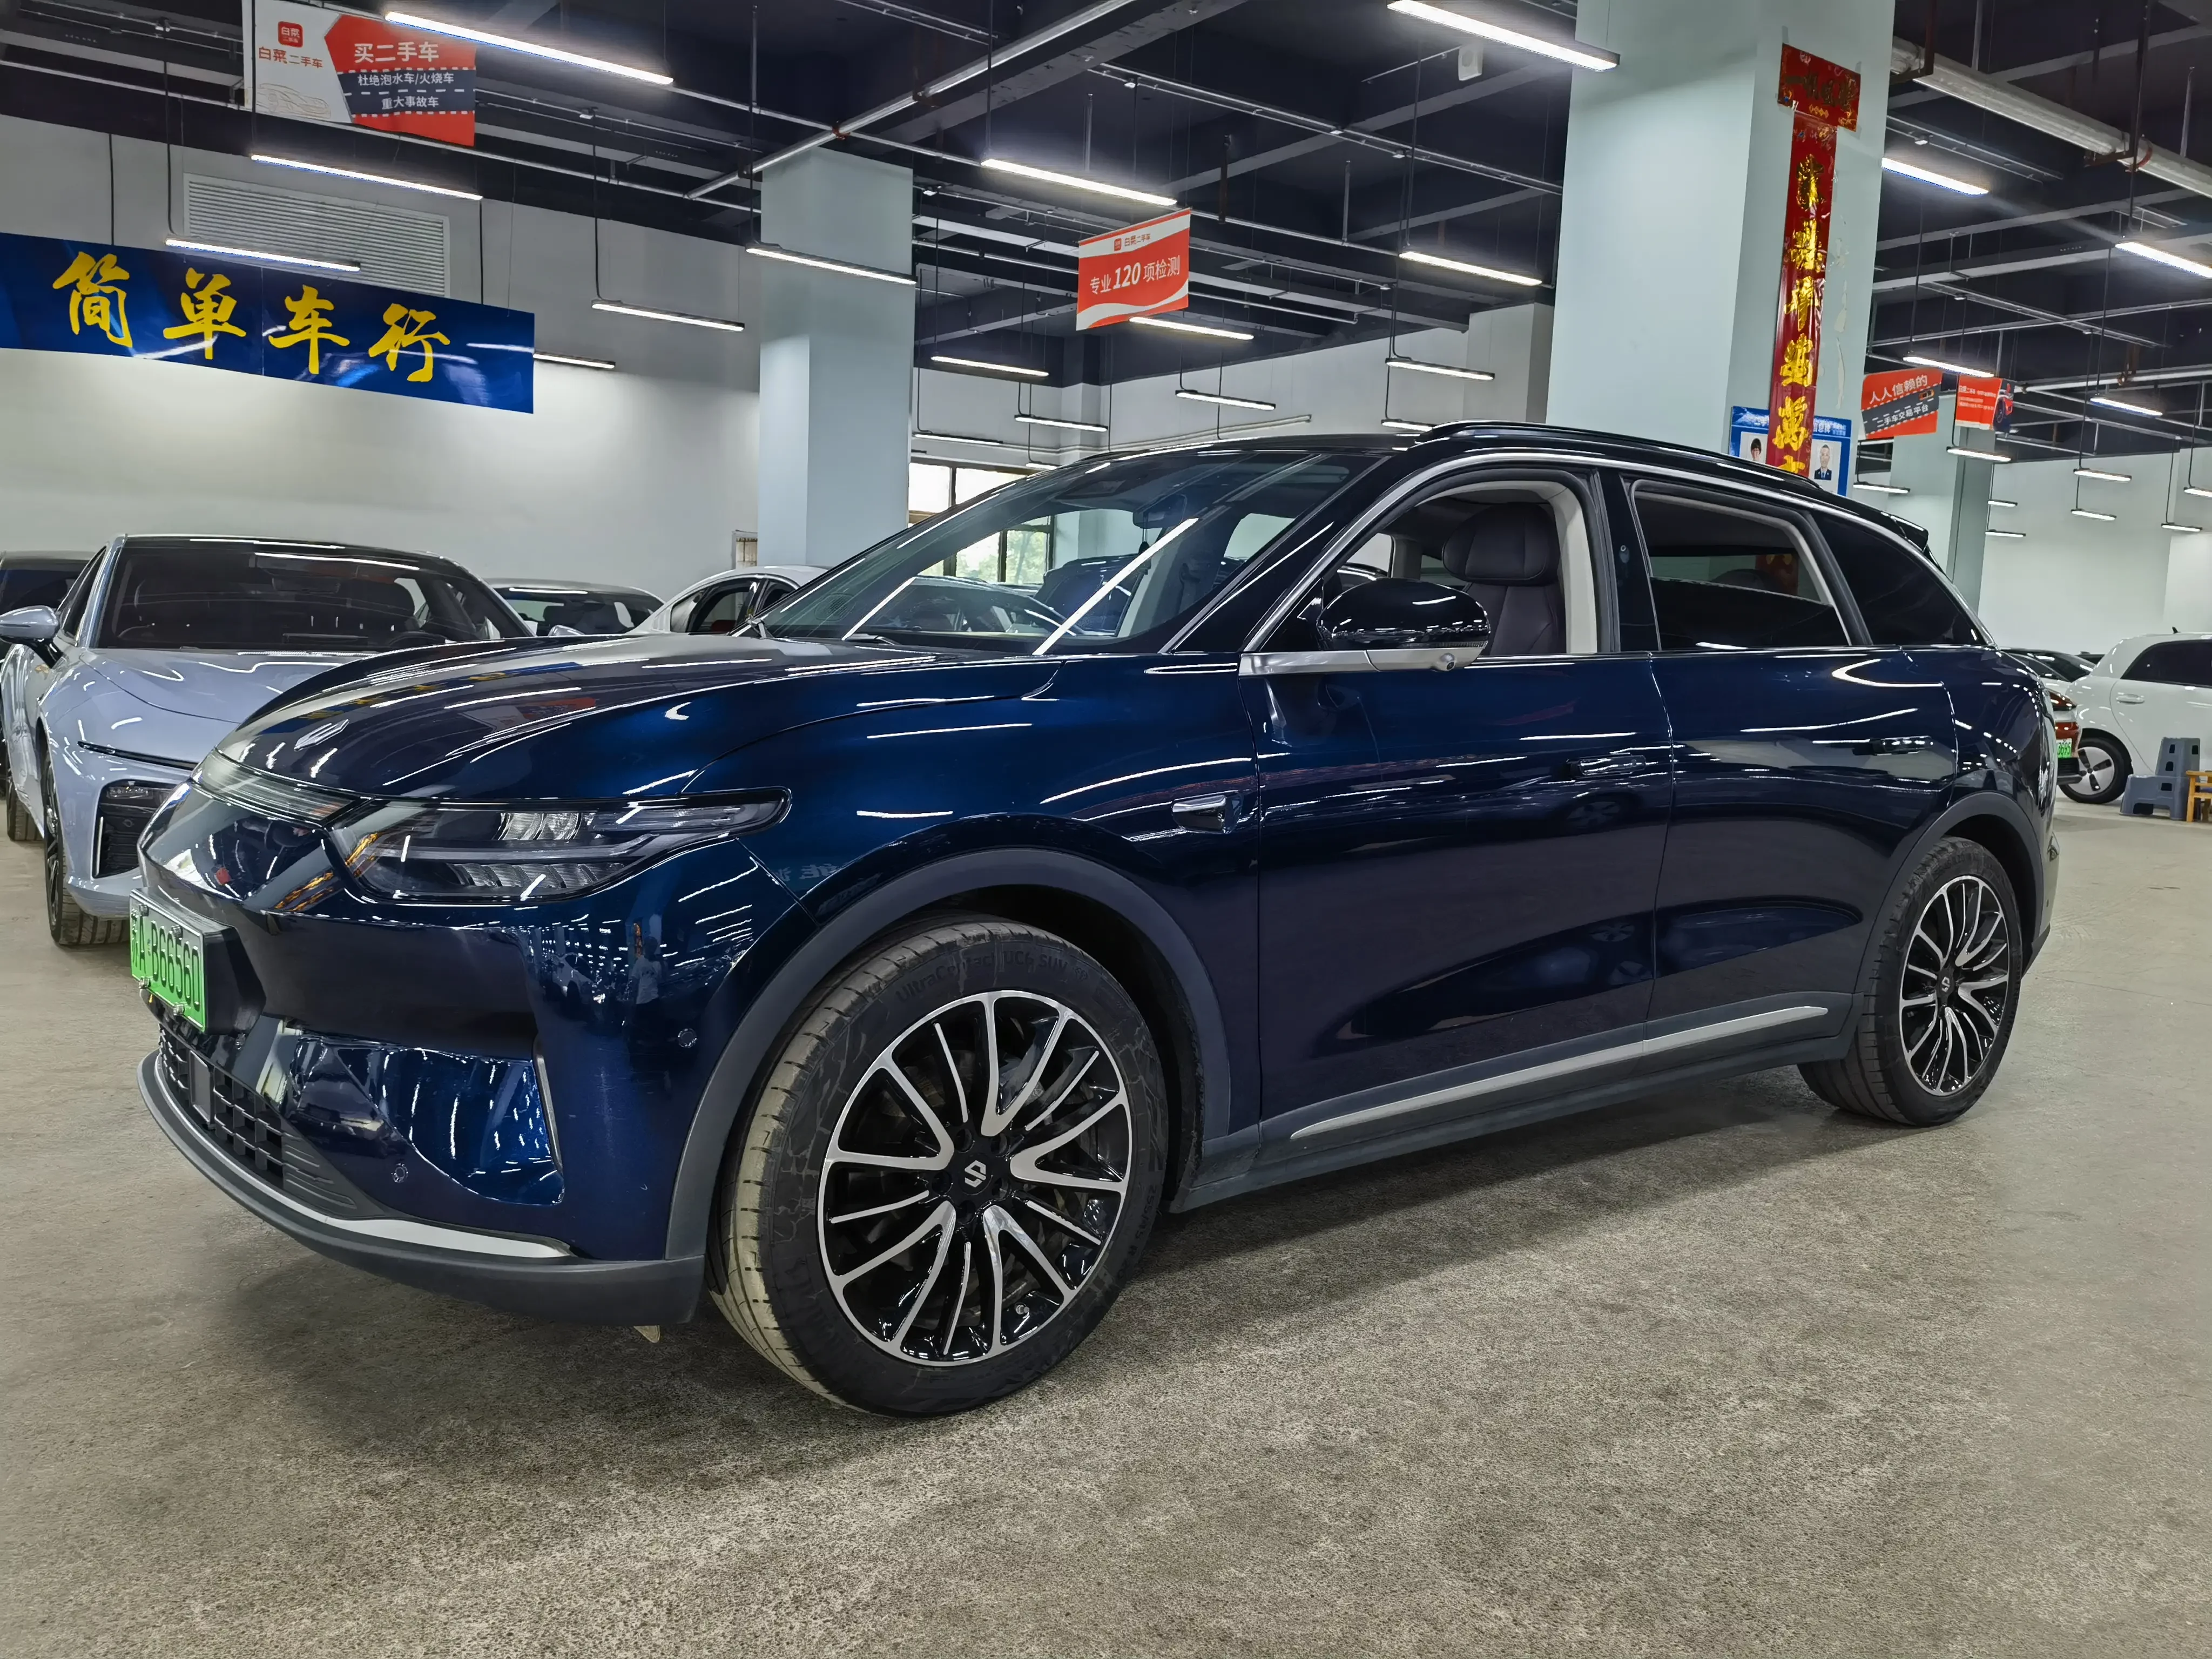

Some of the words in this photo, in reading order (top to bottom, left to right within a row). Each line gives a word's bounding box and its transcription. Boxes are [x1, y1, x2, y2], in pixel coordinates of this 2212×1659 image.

[259, 46, 323, 69] 白菜二手车
[354, 41, 439, 63] 买二手车
[358, 72, 454, 86] 杜绝泡水车/火烧车
[382, 96, 439, 110] 重大事故车
[52, 251, 450, 382] 简单车行
[1869, 374, 1928, 404] 人人信赖的
[1877, 404, 1929, 428] 二手车交易平台
